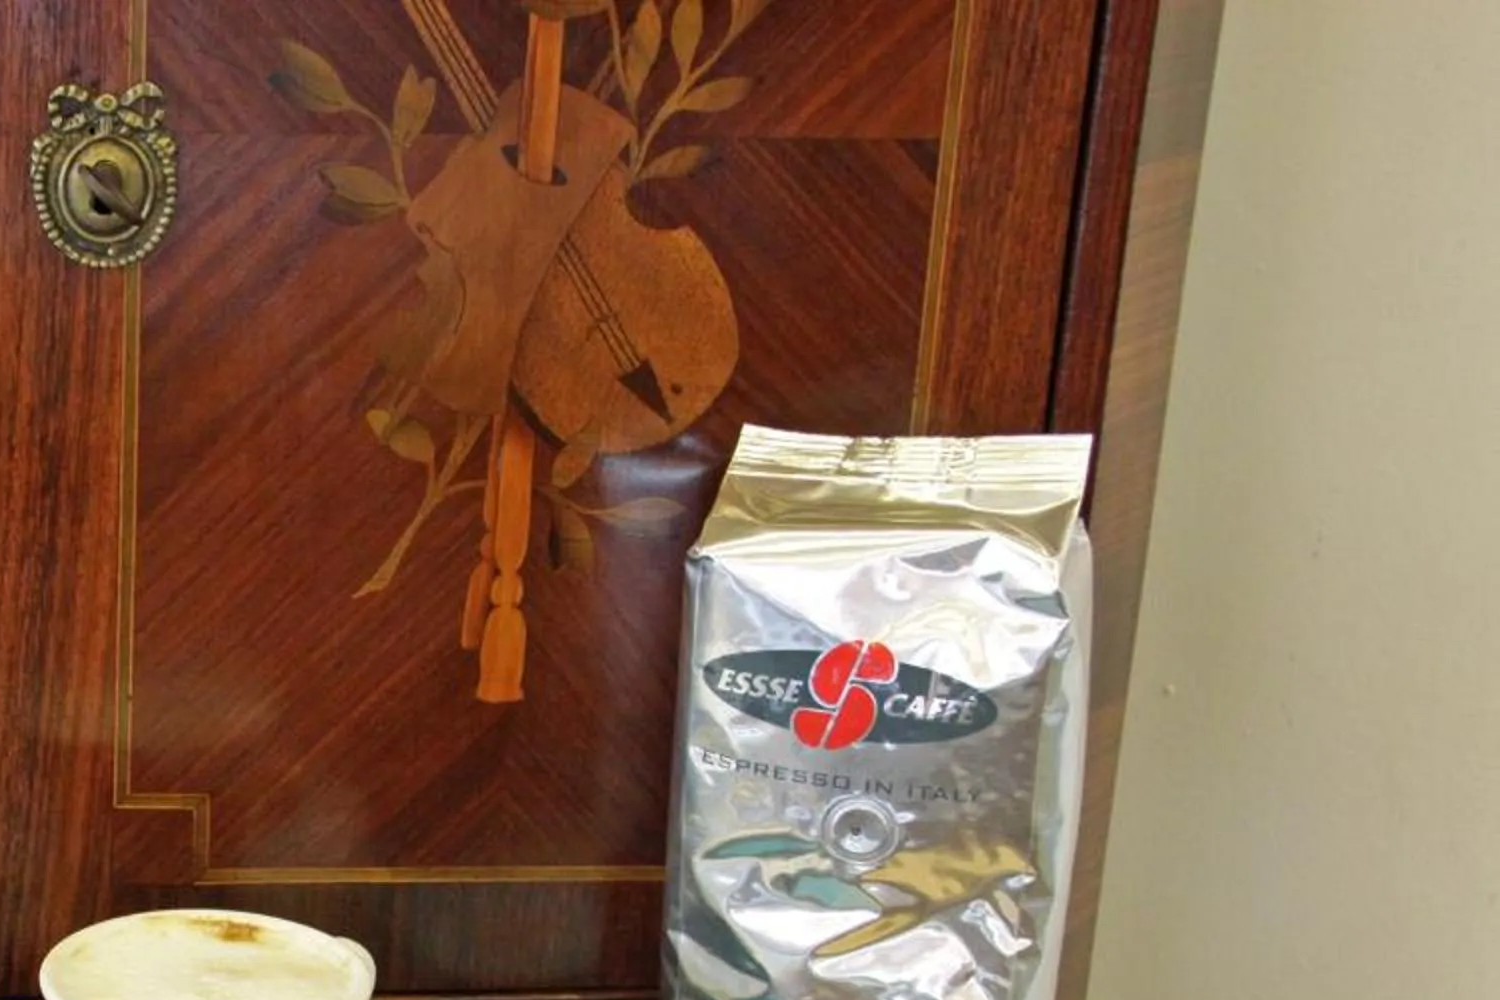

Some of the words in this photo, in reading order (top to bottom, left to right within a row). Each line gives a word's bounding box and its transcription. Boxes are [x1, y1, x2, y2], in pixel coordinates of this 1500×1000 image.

[716, 668, 803, 704] ESSSE
[700, 750, 851, 790] ESPRESSO
[864, 778, 894, 796] IN
[907, 784, 981, 803] ITALY
